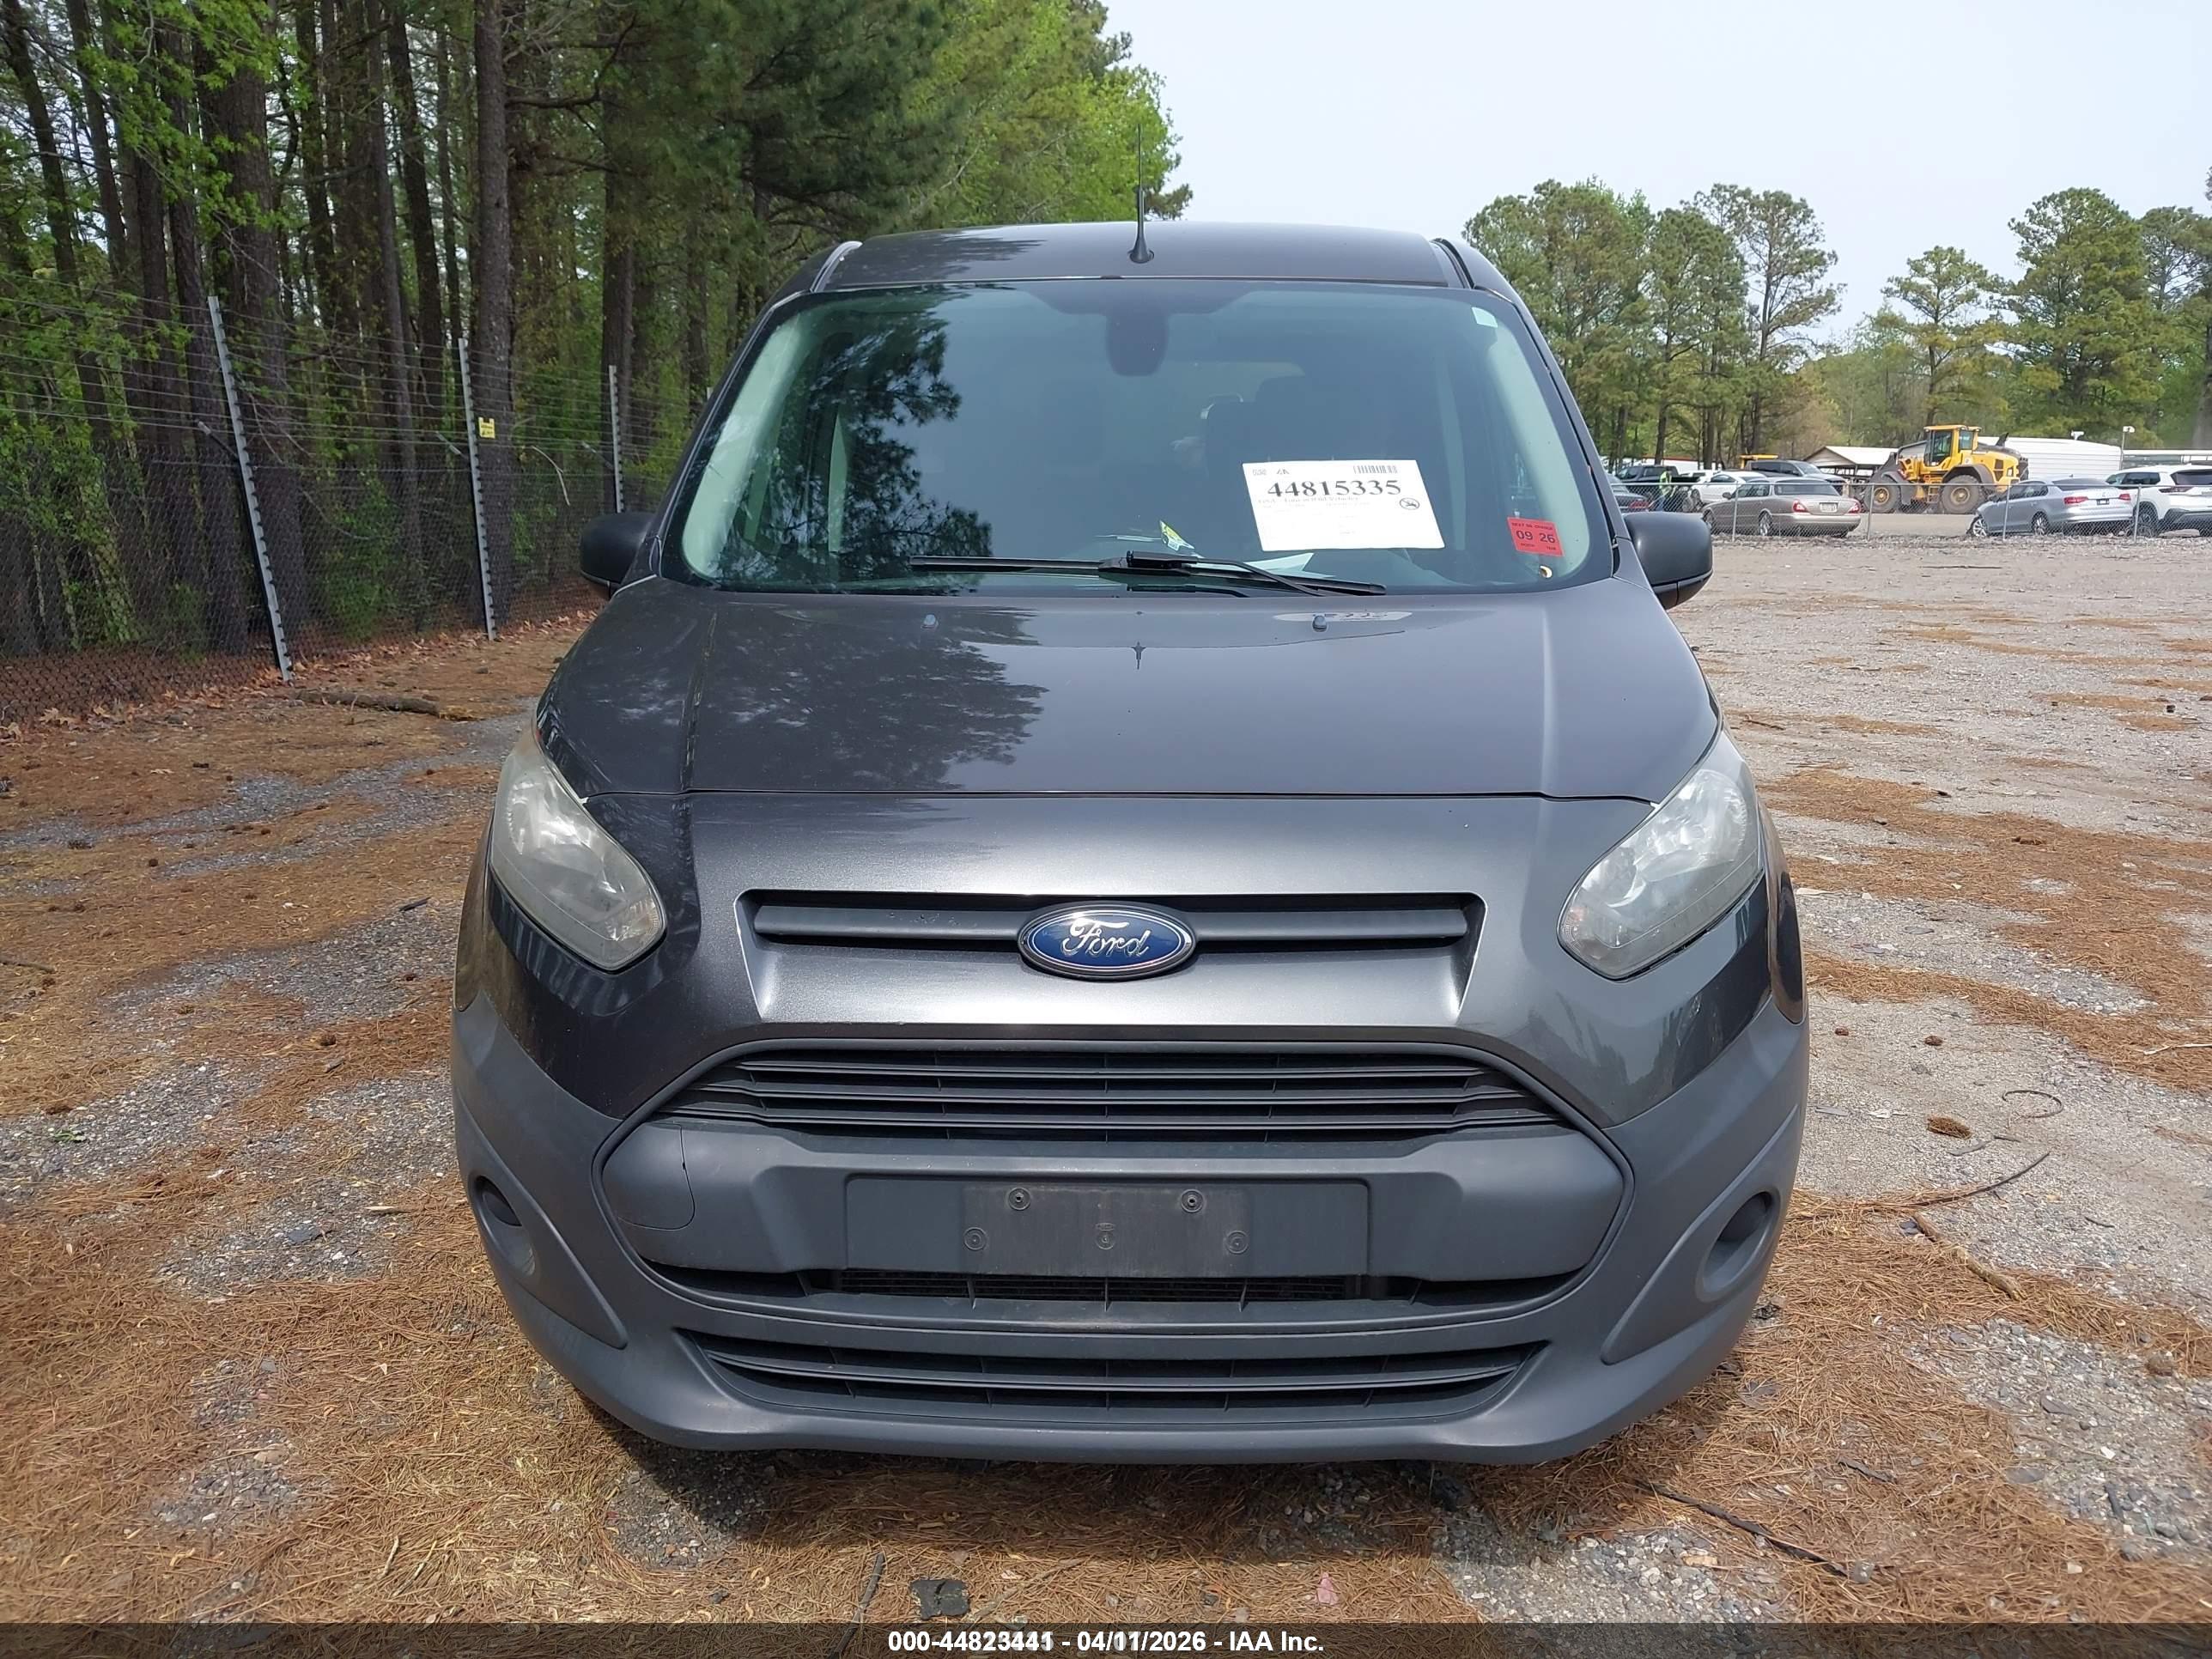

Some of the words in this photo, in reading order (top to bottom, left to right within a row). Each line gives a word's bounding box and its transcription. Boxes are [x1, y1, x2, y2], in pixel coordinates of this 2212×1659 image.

[1267, 480, 1401, 497] 44815335
[1516, 530, 1534, 540] 09
[1539, 532, 1556, 544] 26
[1060, 917, 1152, 957] Ford
